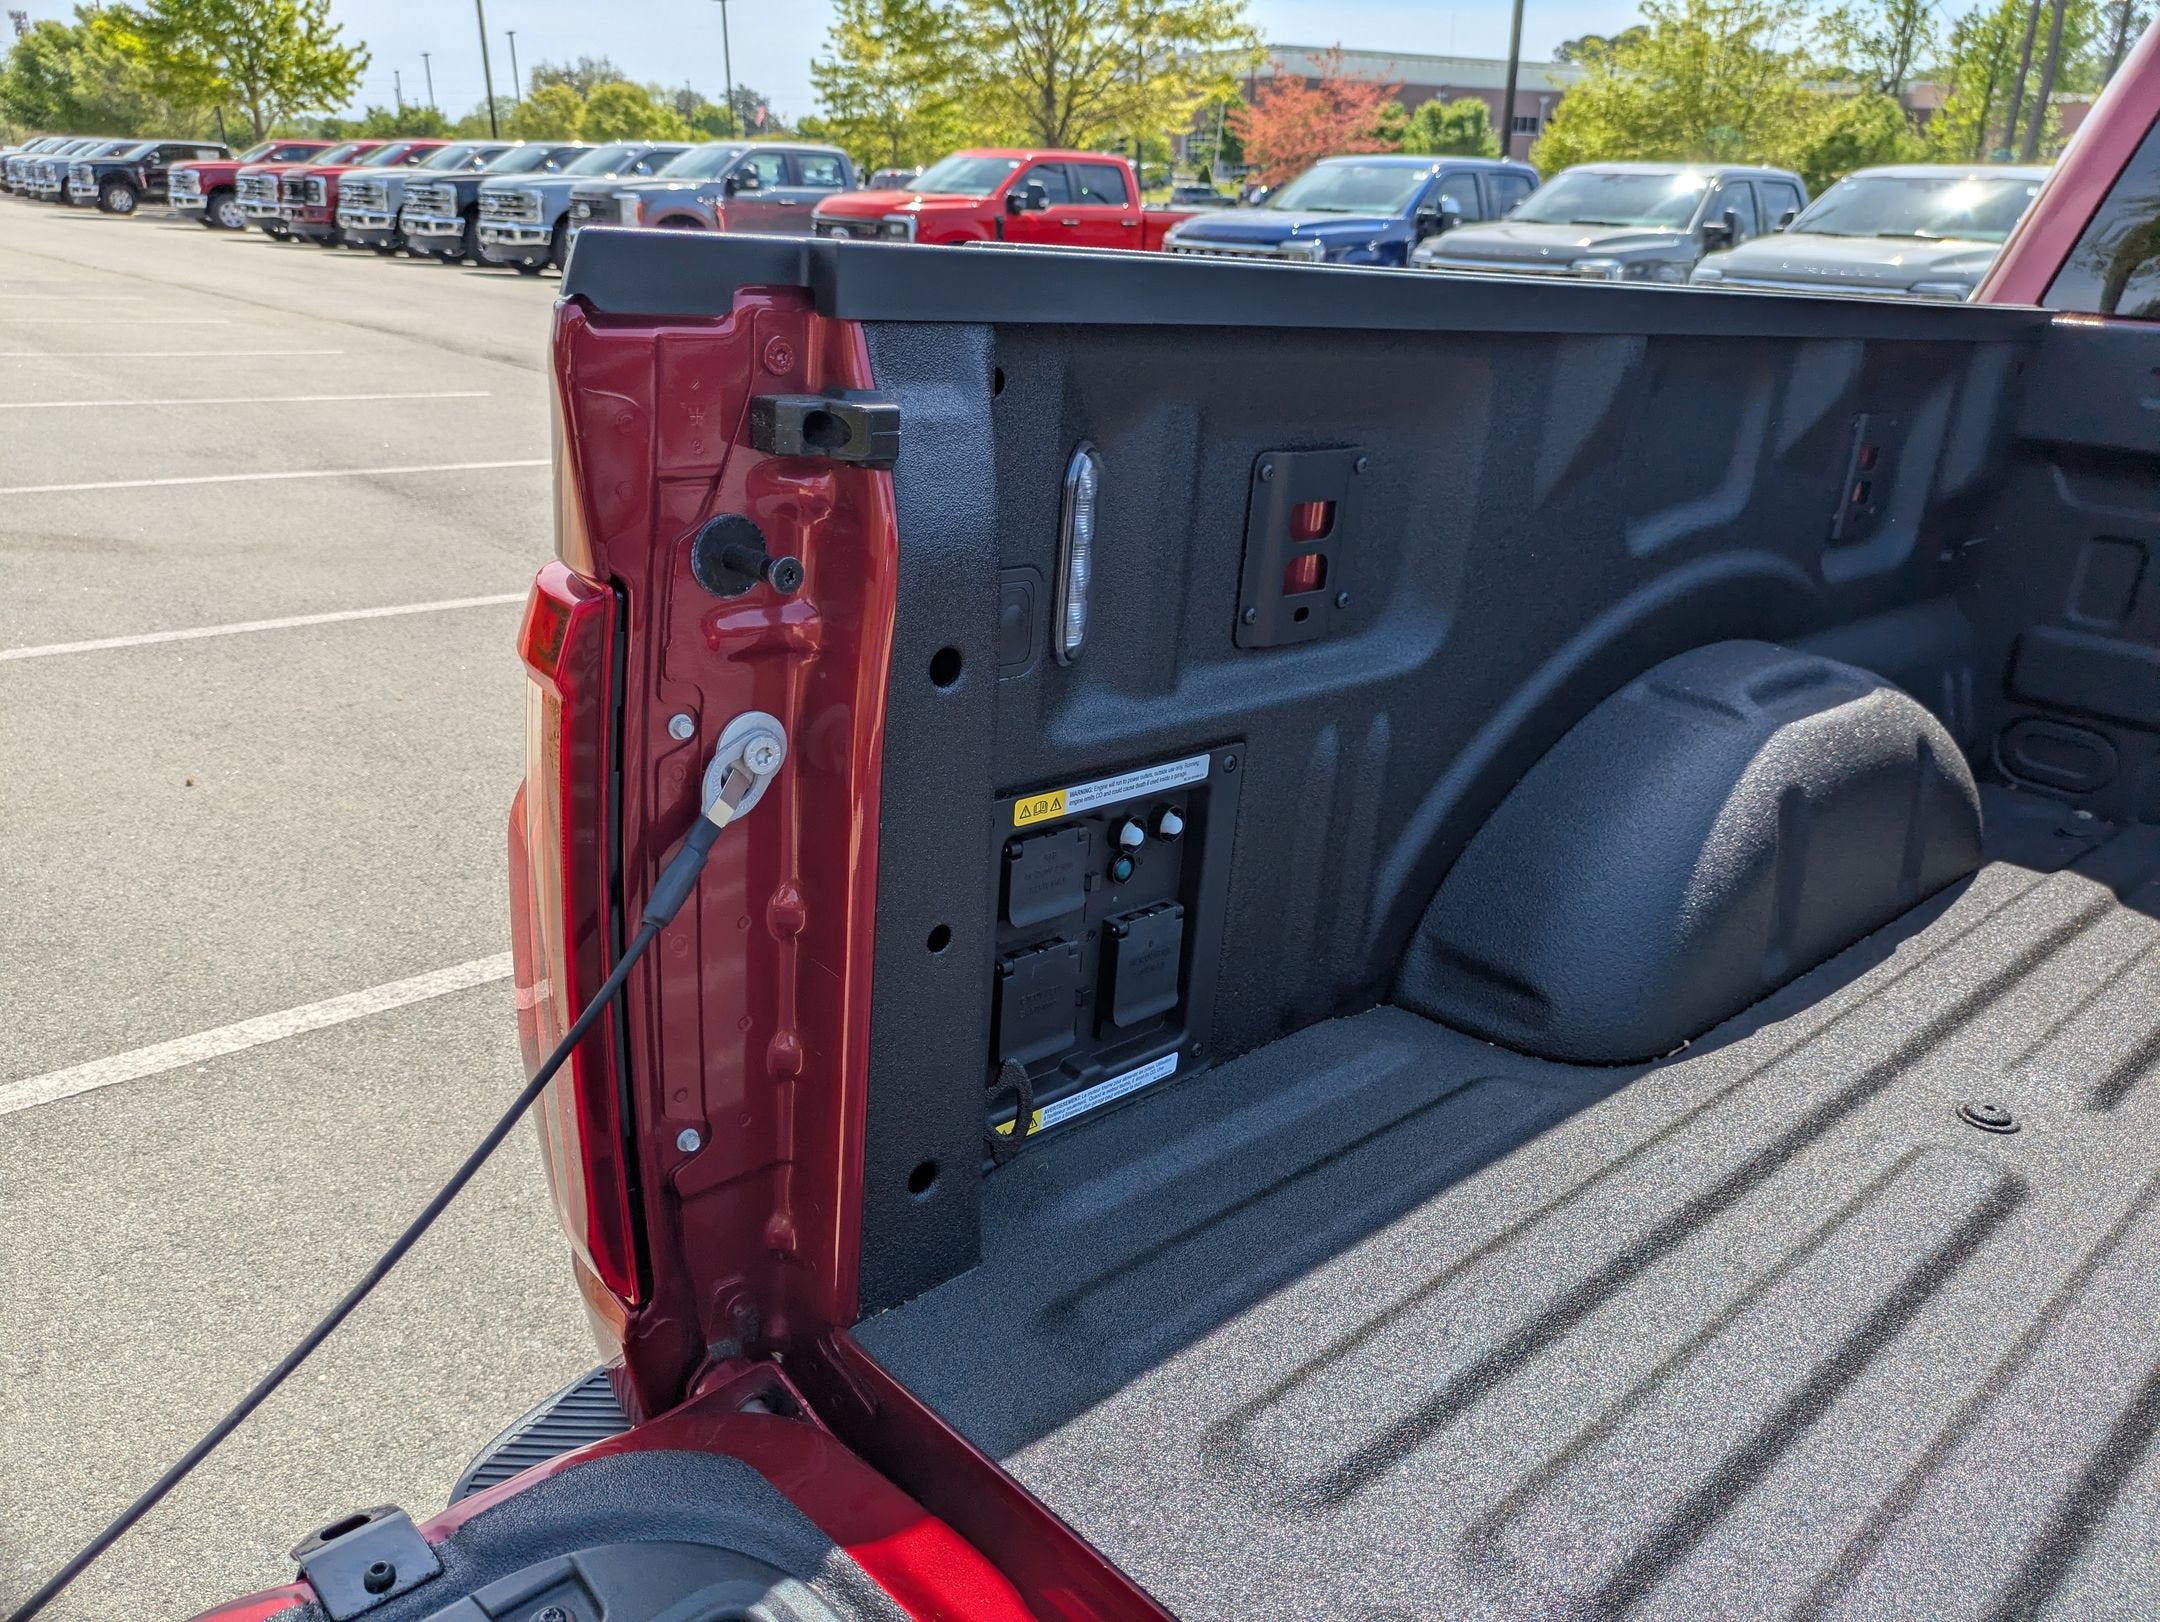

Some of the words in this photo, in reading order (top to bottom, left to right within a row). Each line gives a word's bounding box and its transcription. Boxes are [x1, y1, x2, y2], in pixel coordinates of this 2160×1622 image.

[1070, 787, 1094, 797] WARNING:
[1094, 783, 1108, 792] Engine
[1184, 760, 1199, 769] Running
[1069, 798, 1083, 806] engine
